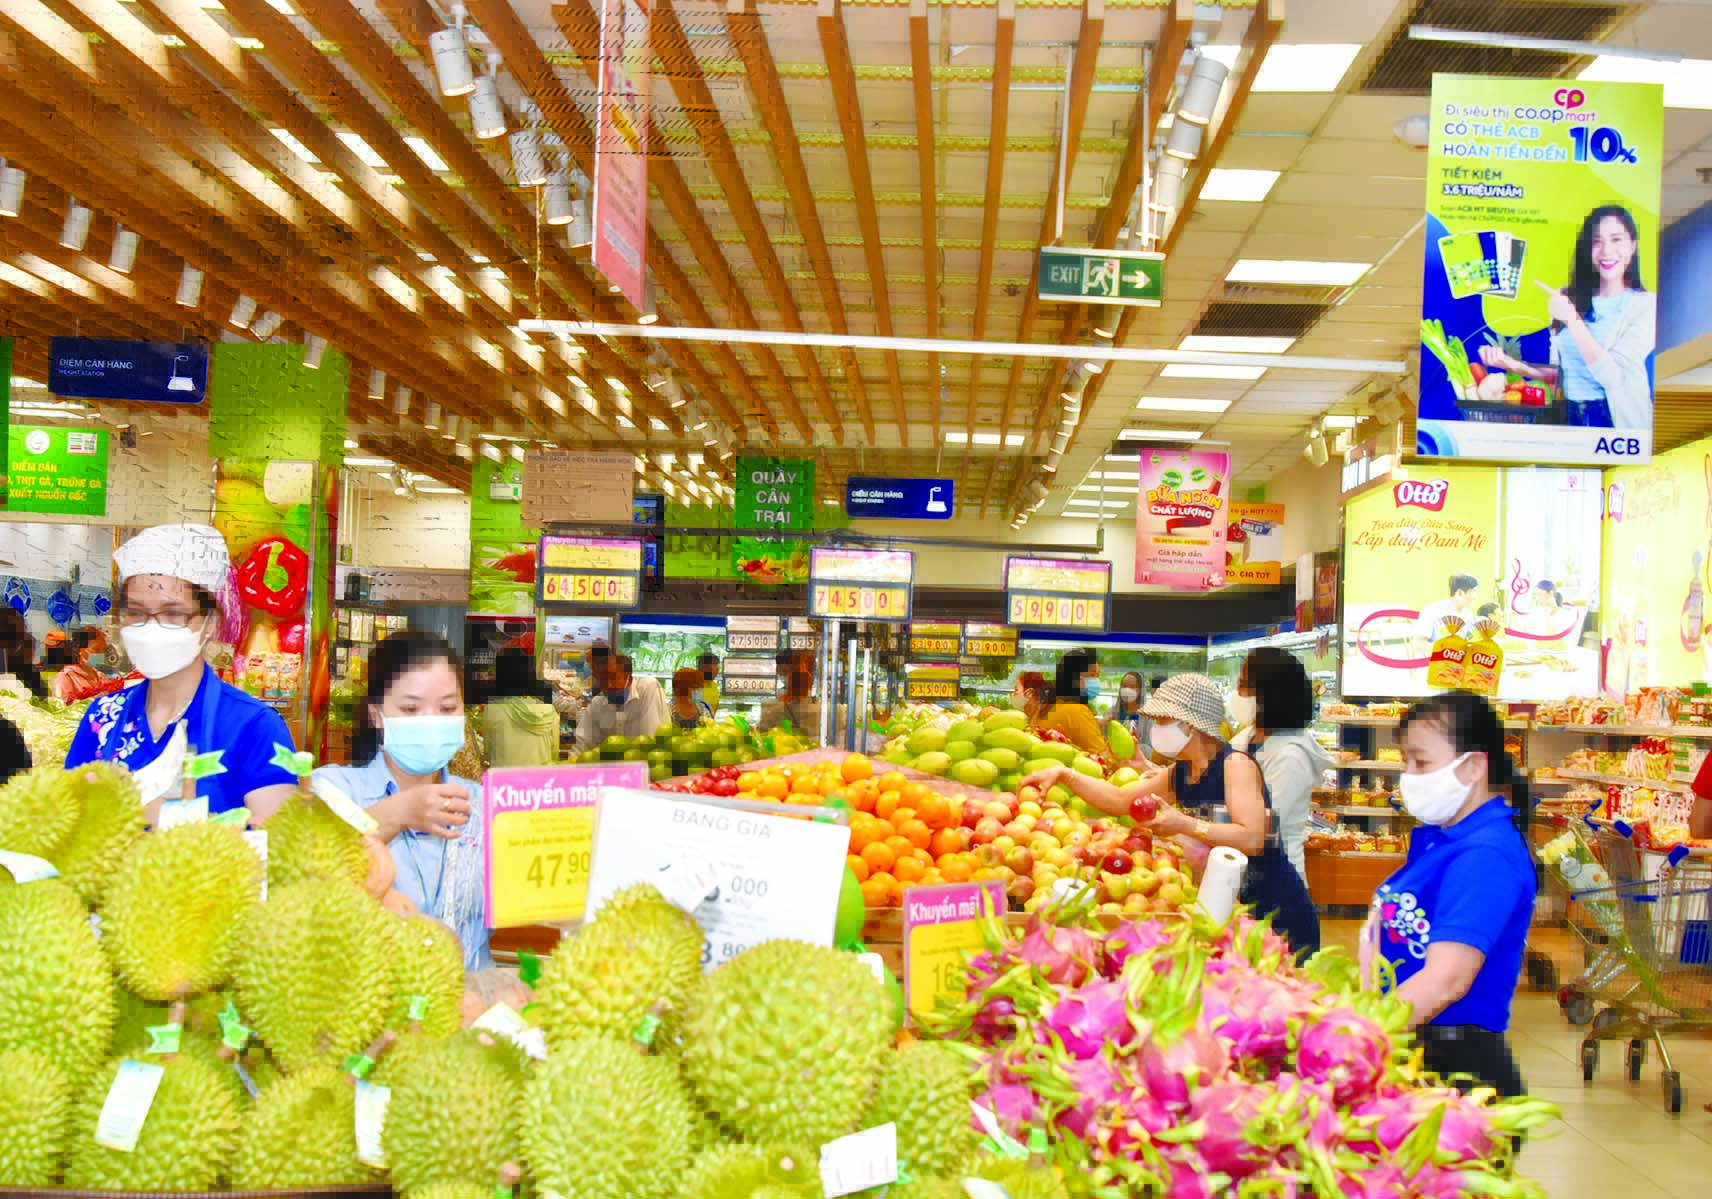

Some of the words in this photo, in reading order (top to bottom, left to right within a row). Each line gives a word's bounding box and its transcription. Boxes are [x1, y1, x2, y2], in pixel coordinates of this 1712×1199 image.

[1443, 143, 1490, 156] HOÀN
[1051, 265, 1080, 284] EXIT
[1595, 437, 1640, 455] ACB
[751, 467, 797, 485] QUẦY
[756, 488, 790, 505] CÂN
[1398, 480, 1447, 505] Otto
[754, 508, 790, 524] TRÁI
[1151, 503, 1177, 515] CHẤT
[493, 778, 566, 810] Khuyến
[910, 895, 957, 924] Khuyến
